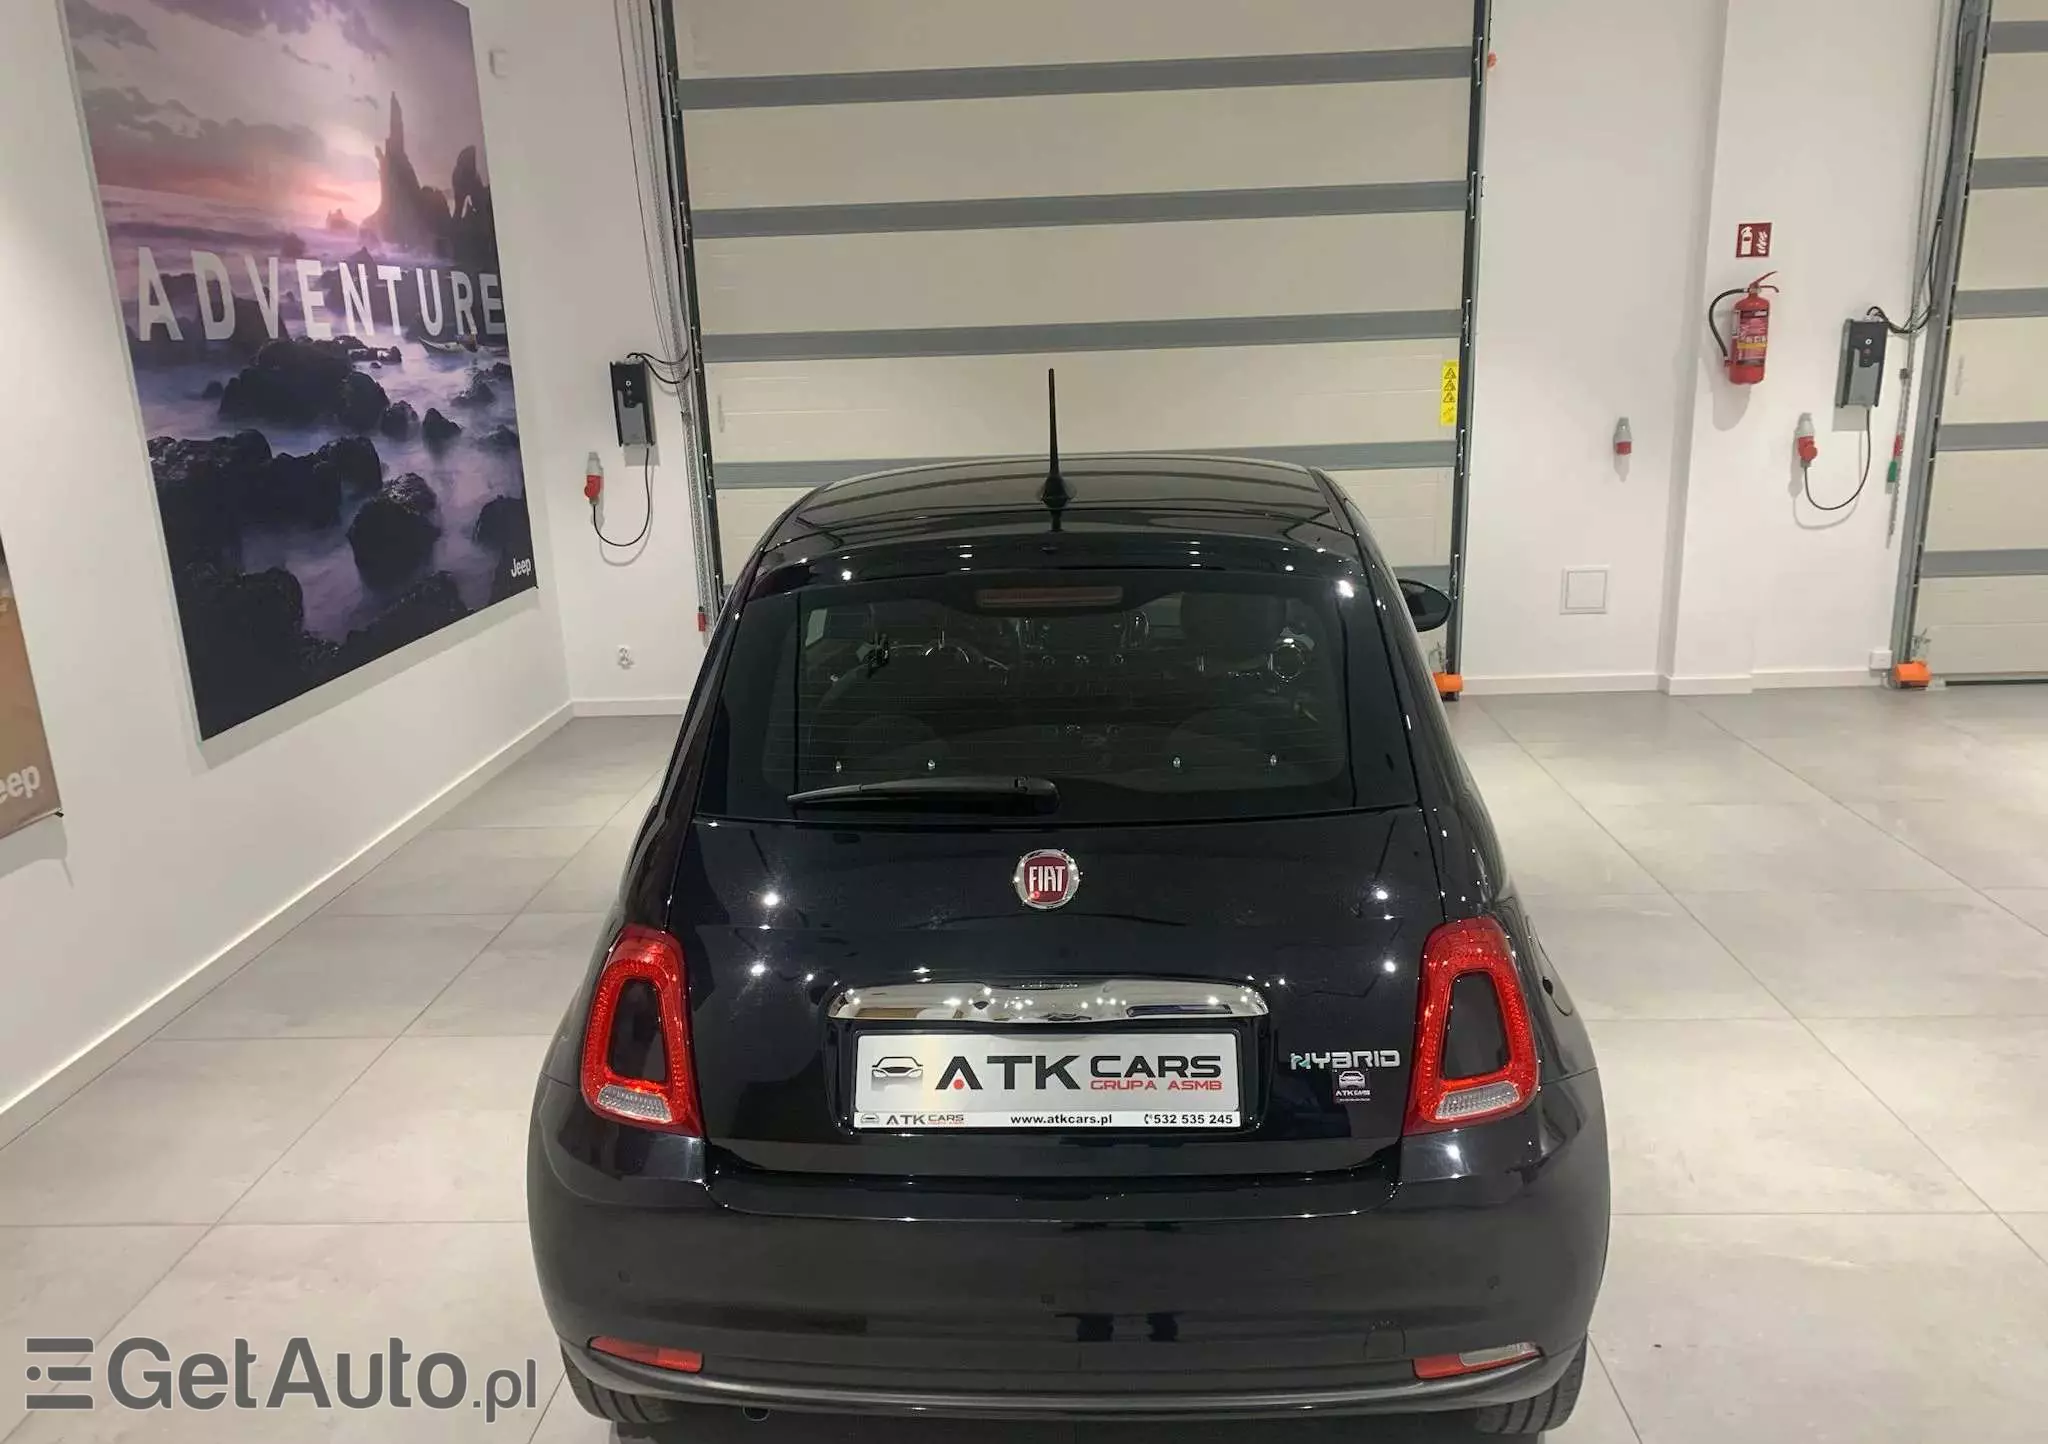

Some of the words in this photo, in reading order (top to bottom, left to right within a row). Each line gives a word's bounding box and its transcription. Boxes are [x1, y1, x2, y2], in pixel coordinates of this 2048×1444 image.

[137, 246, 506, 343] ADVENTURE
[510, 558, 532, 577] Jeep
[1029, 865, 1066, 892] FIAT
[1290, 1050, 1401, 1070] HYBRID
[935, 1055, 1081, 1090] ATK
[1090, 1055, 1222, 1078] CARS
[1090, 1079, 1157, 1091] GRUPA
[1167, 1079, 1223, 1091] ASMB
[886, 1114, 926, 1125] ATK
[1010, 1113, 1113, 1126] www.atkcars.pl
[1153, 1114, 1177, 1124] 532
[1181, 1114, 1205, 1124] 535
[1209, 1114, 1233, 1124] 245
